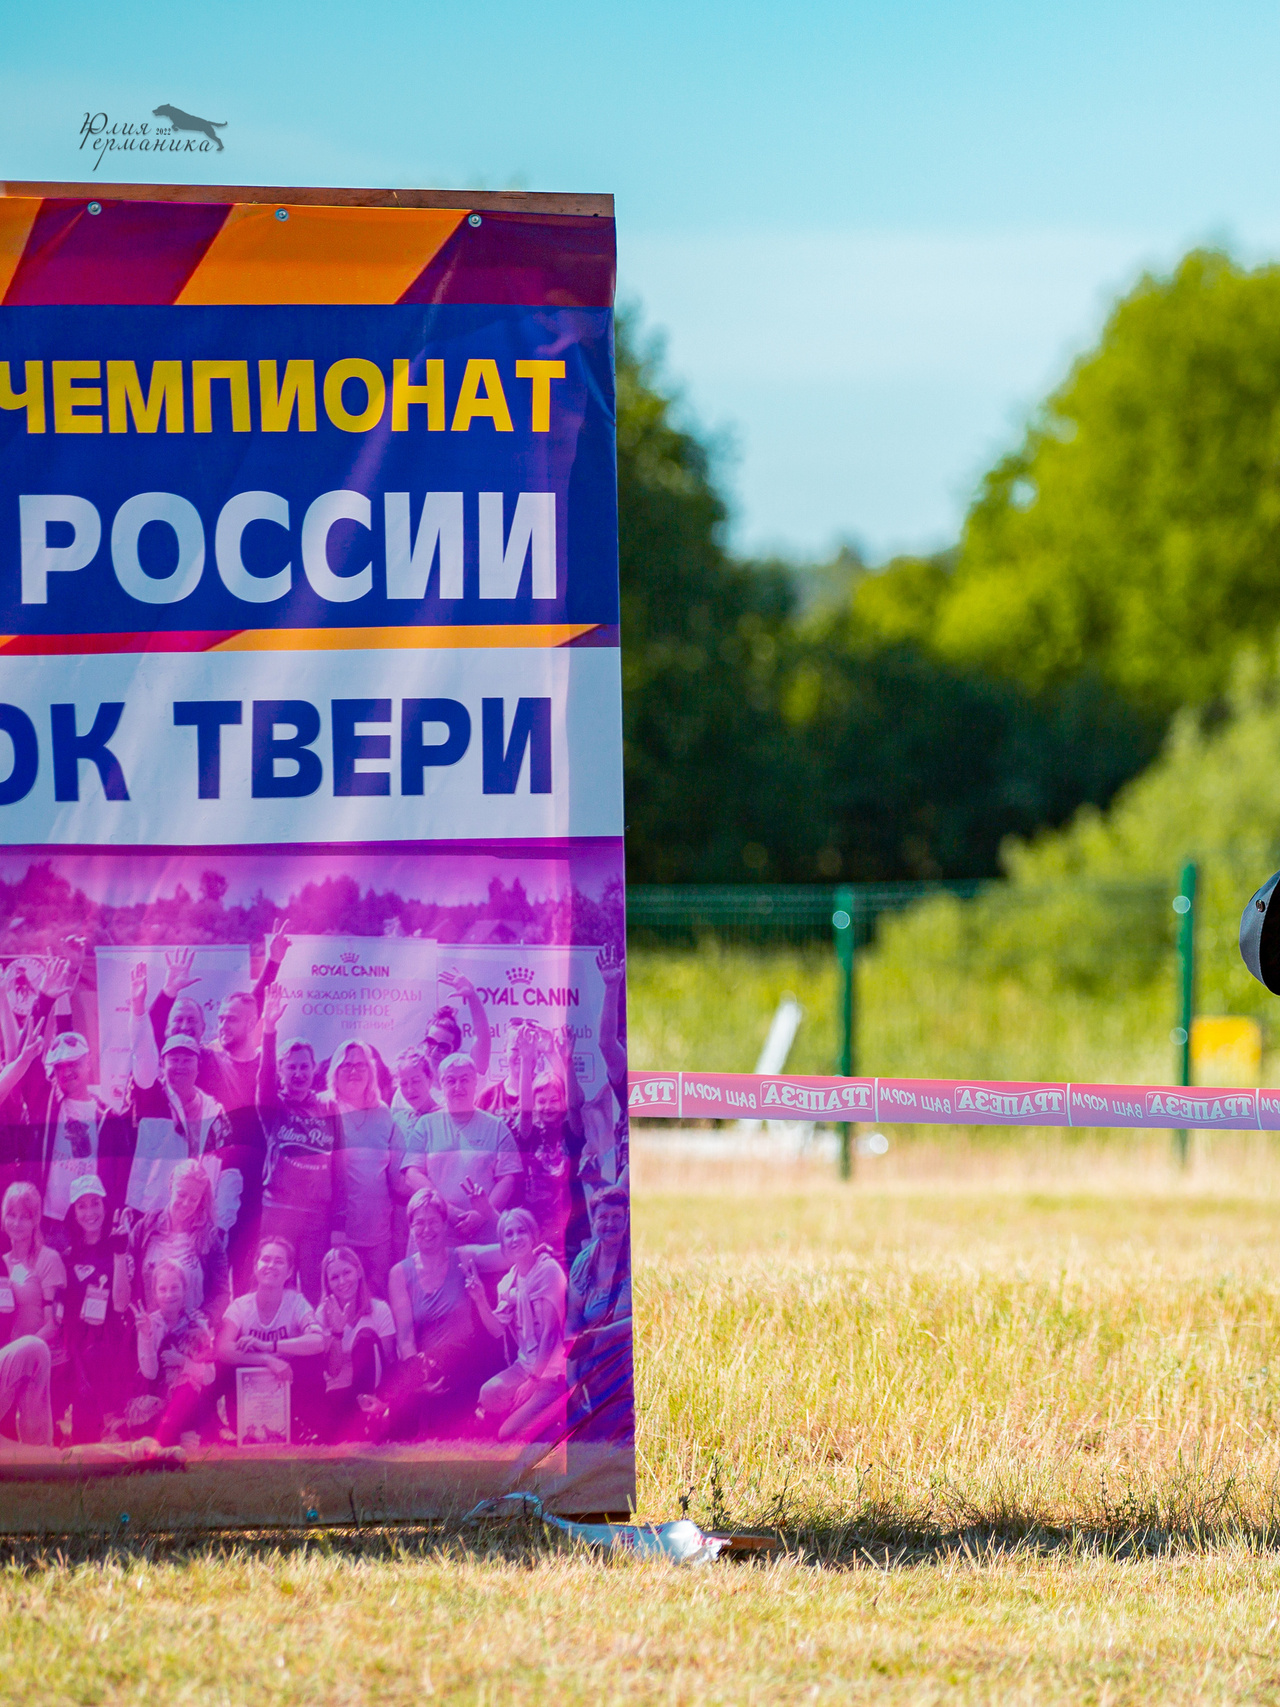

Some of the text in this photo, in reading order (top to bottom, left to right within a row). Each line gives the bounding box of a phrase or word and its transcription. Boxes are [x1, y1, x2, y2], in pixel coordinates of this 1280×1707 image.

[0, 358, 566, 434] ЧЕМПИОНАТ
[19, 490, 557, 604] РОССИИ
[173, 697, 553, 799] ТВЕРИ
[311, 964, 390, 978] ROYAL CANIN
[307, 988, 356, 1001] каждой
[360, 987, 422, 1002] ПОРОДЫ
[463, 987, 580, 1007] OYAL CANIN
[302, 1003, 391, 1017] ОСОБЕННОЕ
